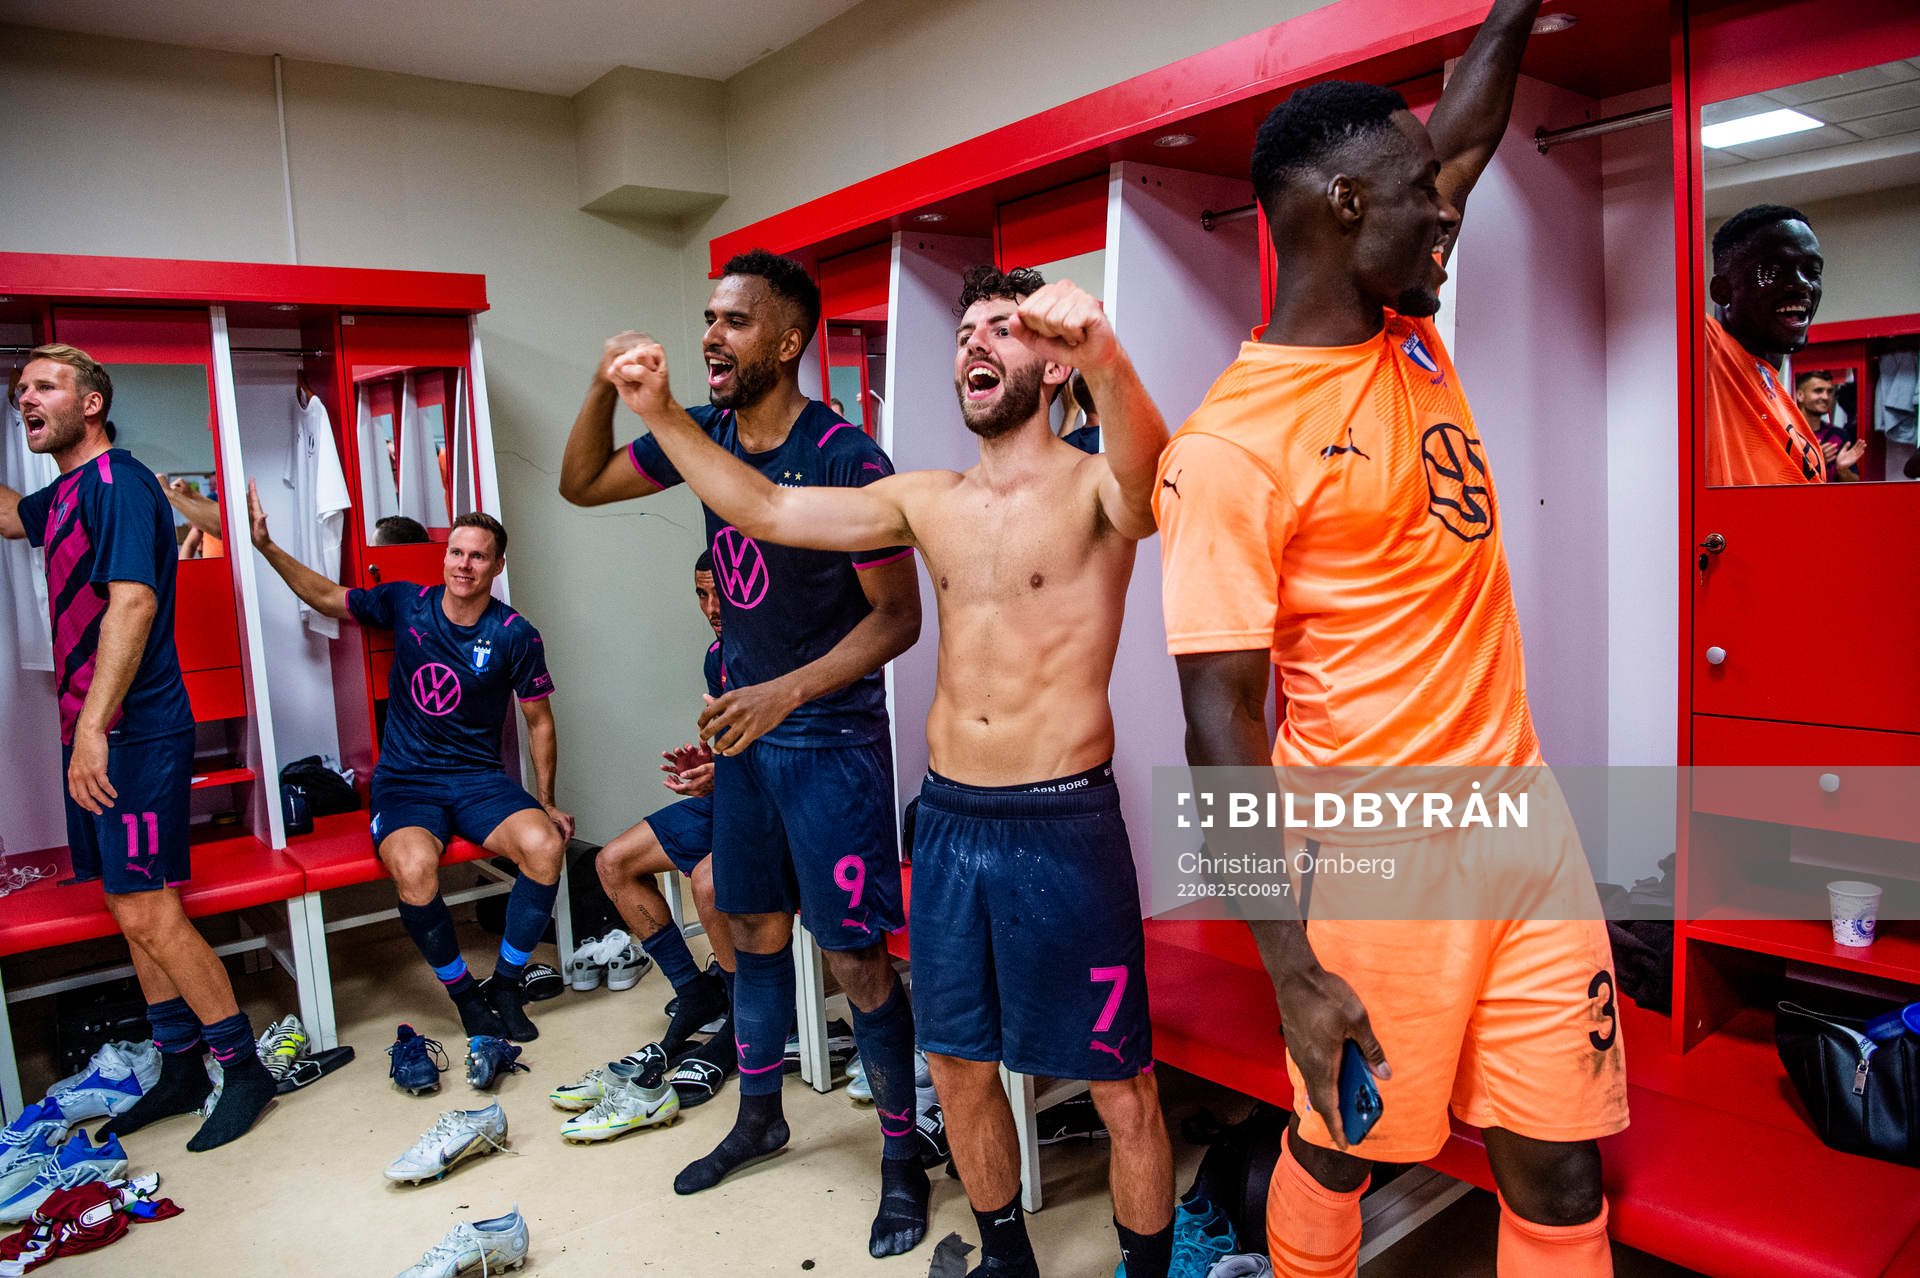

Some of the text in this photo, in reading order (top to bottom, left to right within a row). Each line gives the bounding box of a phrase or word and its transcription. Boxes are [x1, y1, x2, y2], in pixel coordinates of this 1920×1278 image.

[412, 663, 461, 716] VW
[1058, 778, 1089, 792] BORG
[121, 811, 159, 857] 11
[833, 854, 866, 909] 9
[1089, 965, 1129, 1033] 7
[1587, 969, 1617, 1051] 3
